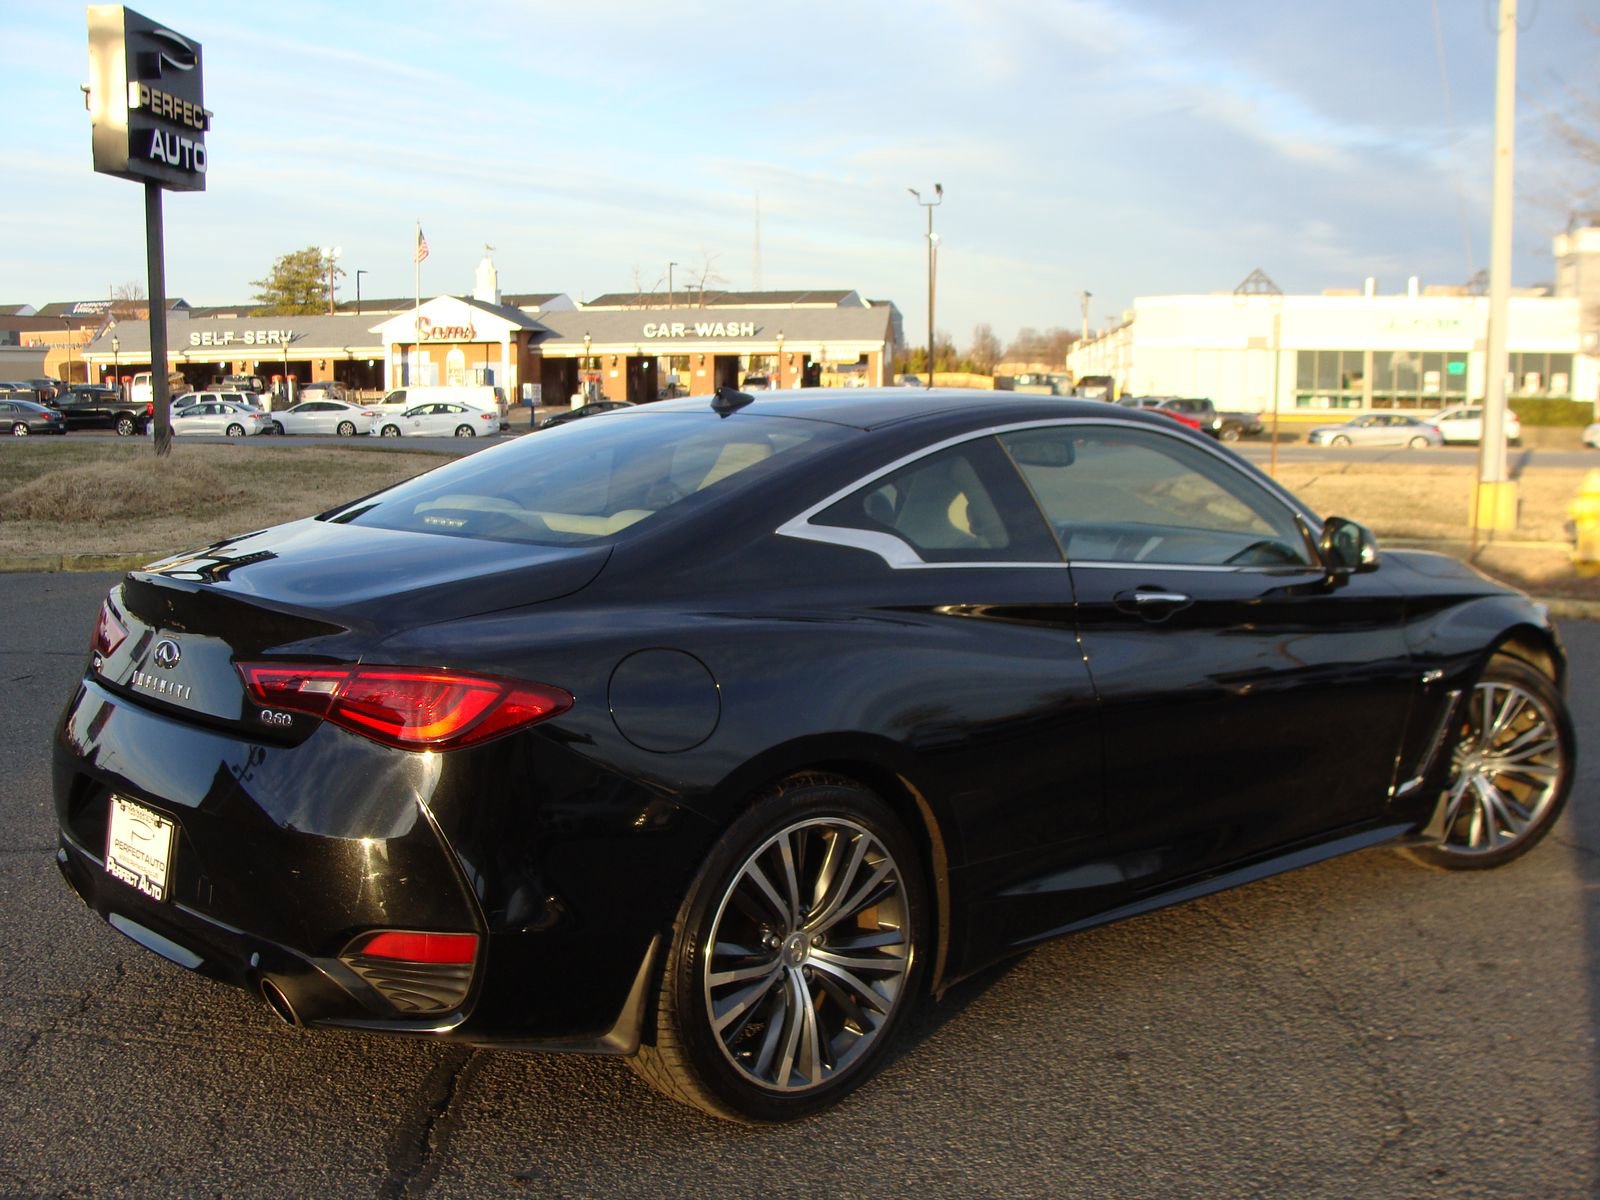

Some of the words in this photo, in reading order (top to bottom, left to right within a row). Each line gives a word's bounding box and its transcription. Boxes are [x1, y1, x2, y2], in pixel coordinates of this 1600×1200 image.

[134, 82, 214, 132] PERFECT
[149, 128, 208, 173] AUTO
[190, 331, 235, 346] SELF
[244, 329, 293, 345] SERV
[643, 322, 685, 338] CAR
[694, 321, 755, 337] WASH
[131, 670, 191, 700] INFINITI
[261, 709, 293, 727] Q60
[114, 838, 146, 861] PERFECT
[145, 854, 166, 872] AUTO
[106, 856, 139, 887] PERFECT
[138, 874, 162, 901] AUTO
